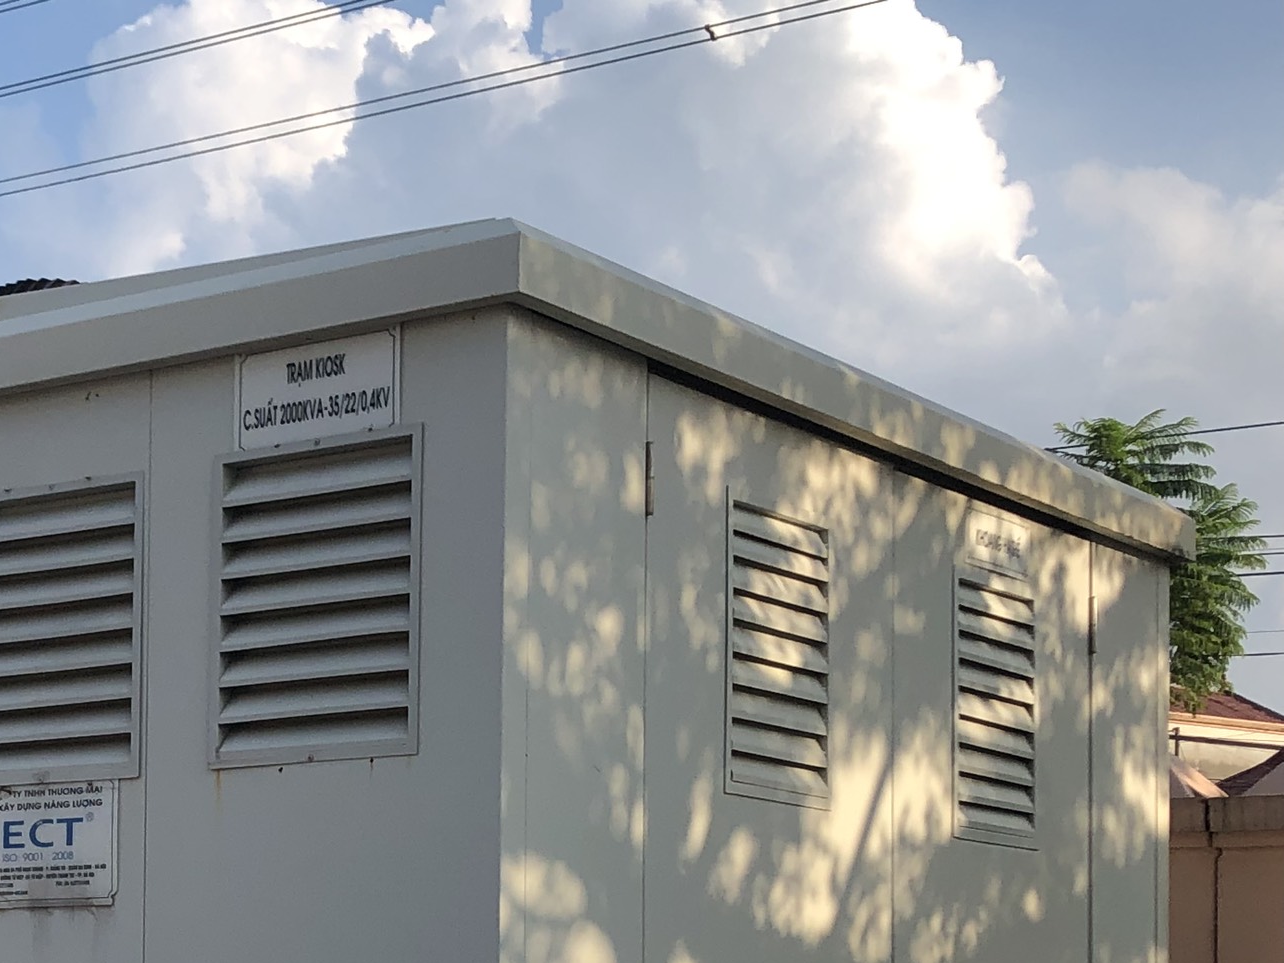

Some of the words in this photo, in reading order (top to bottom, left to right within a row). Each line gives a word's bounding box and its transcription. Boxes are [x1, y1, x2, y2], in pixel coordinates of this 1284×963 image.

[286, 359, 313, 387] TRẠM
[315, 353, 346, 379] KIOSK
[243, 398, 278, 431] C.SUẤT
[12, 790, 22, 798] TY
[3, 817, 83, 849] ECT
[2, 853, 18, 862] ISO
[22, 852, 43, 861] 9001
[52, 851, 74, 861] 2008
